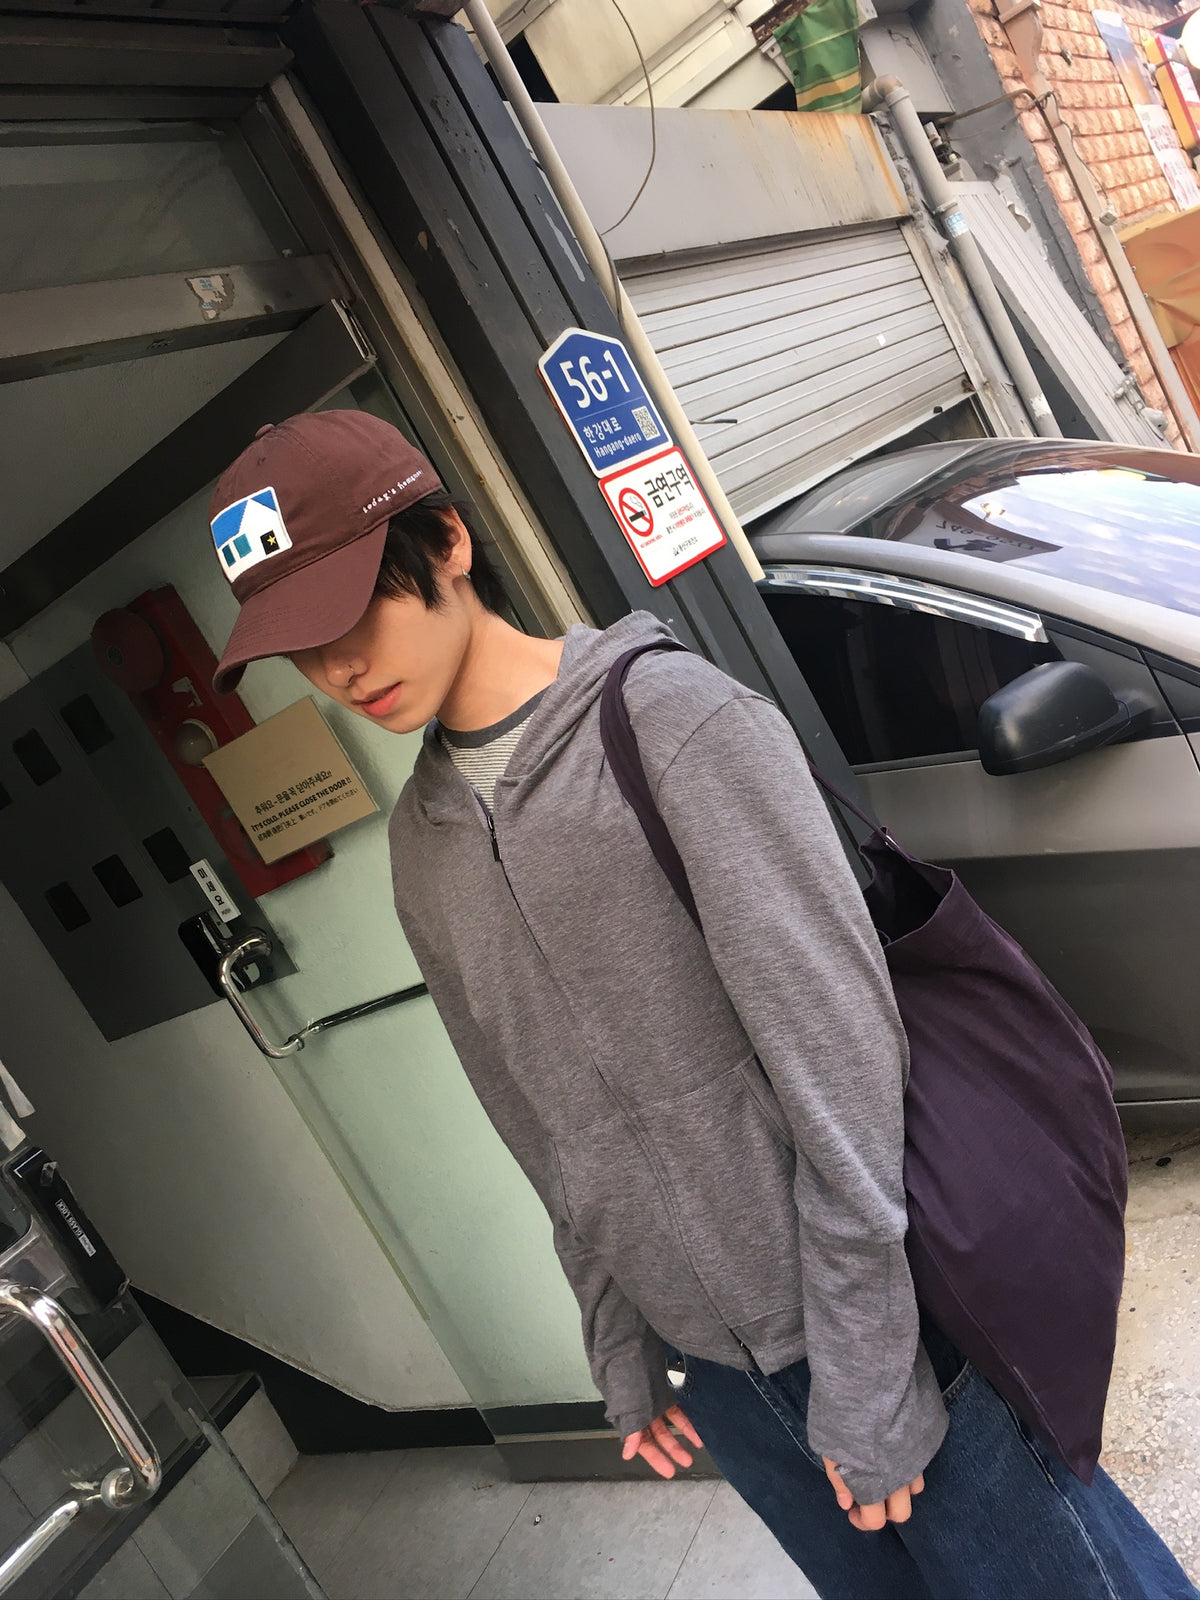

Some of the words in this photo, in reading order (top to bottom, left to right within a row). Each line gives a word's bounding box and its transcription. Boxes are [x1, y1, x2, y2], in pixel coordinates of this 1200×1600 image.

[559, 349, 631, 409] 56-1
[583, 416, 622, 444] 한강대로
[593, 432, 642, 458] Hangang-daero
[644, 463, 695, 508] 금연구역
[362, 488, 397, 514] today's
[278, 803, 300, 819] PLEASE
[299, 794, 317, 808] CLOSE
[316, 788, 330, 799] THE
[328, 779, 349, 794] DOOR
[57, 1200, 71, 1220] LOCK
